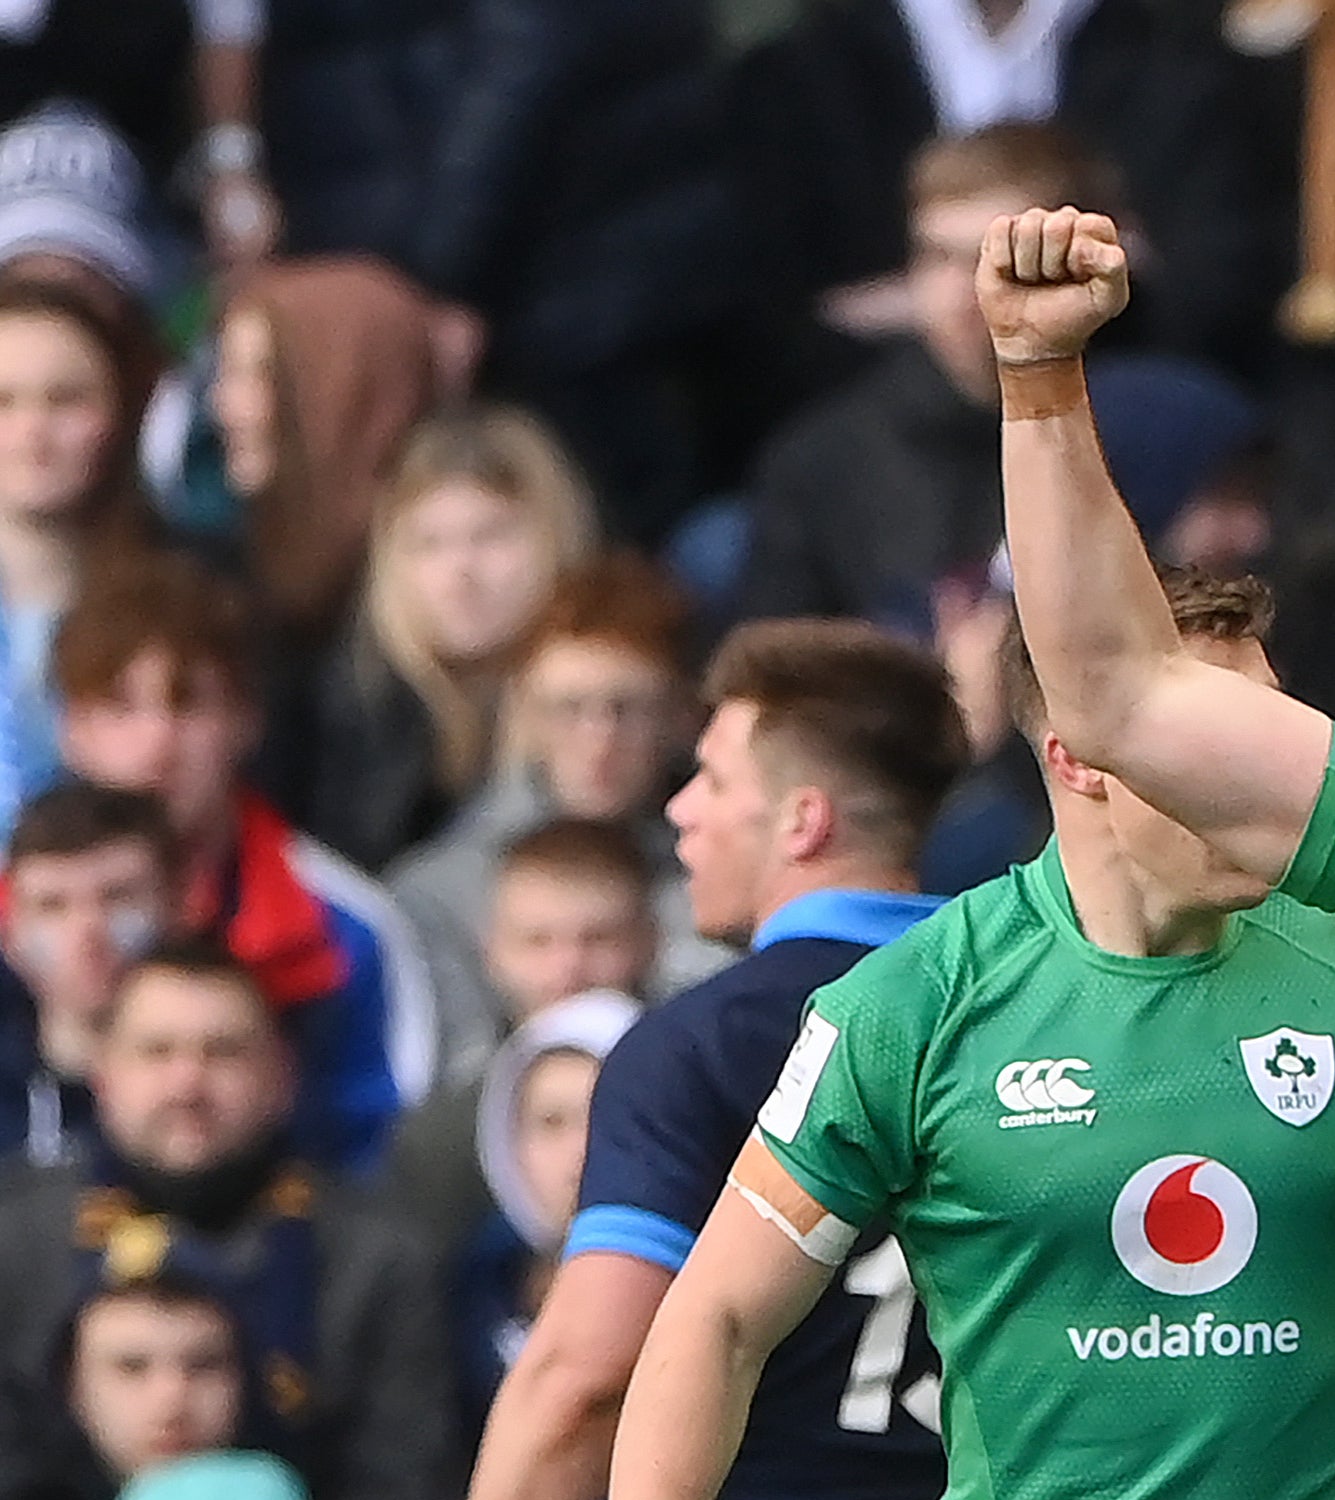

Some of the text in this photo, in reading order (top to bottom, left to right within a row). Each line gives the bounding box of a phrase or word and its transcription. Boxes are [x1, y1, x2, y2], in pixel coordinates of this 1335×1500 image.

[998, 1106, 1097, 1129] canterbury
[1277, 1093, 1317, 1111] IRFU
[837, 1233, 942, 1434] 1
[1066, 1311, 1301, 1360] vodafone
